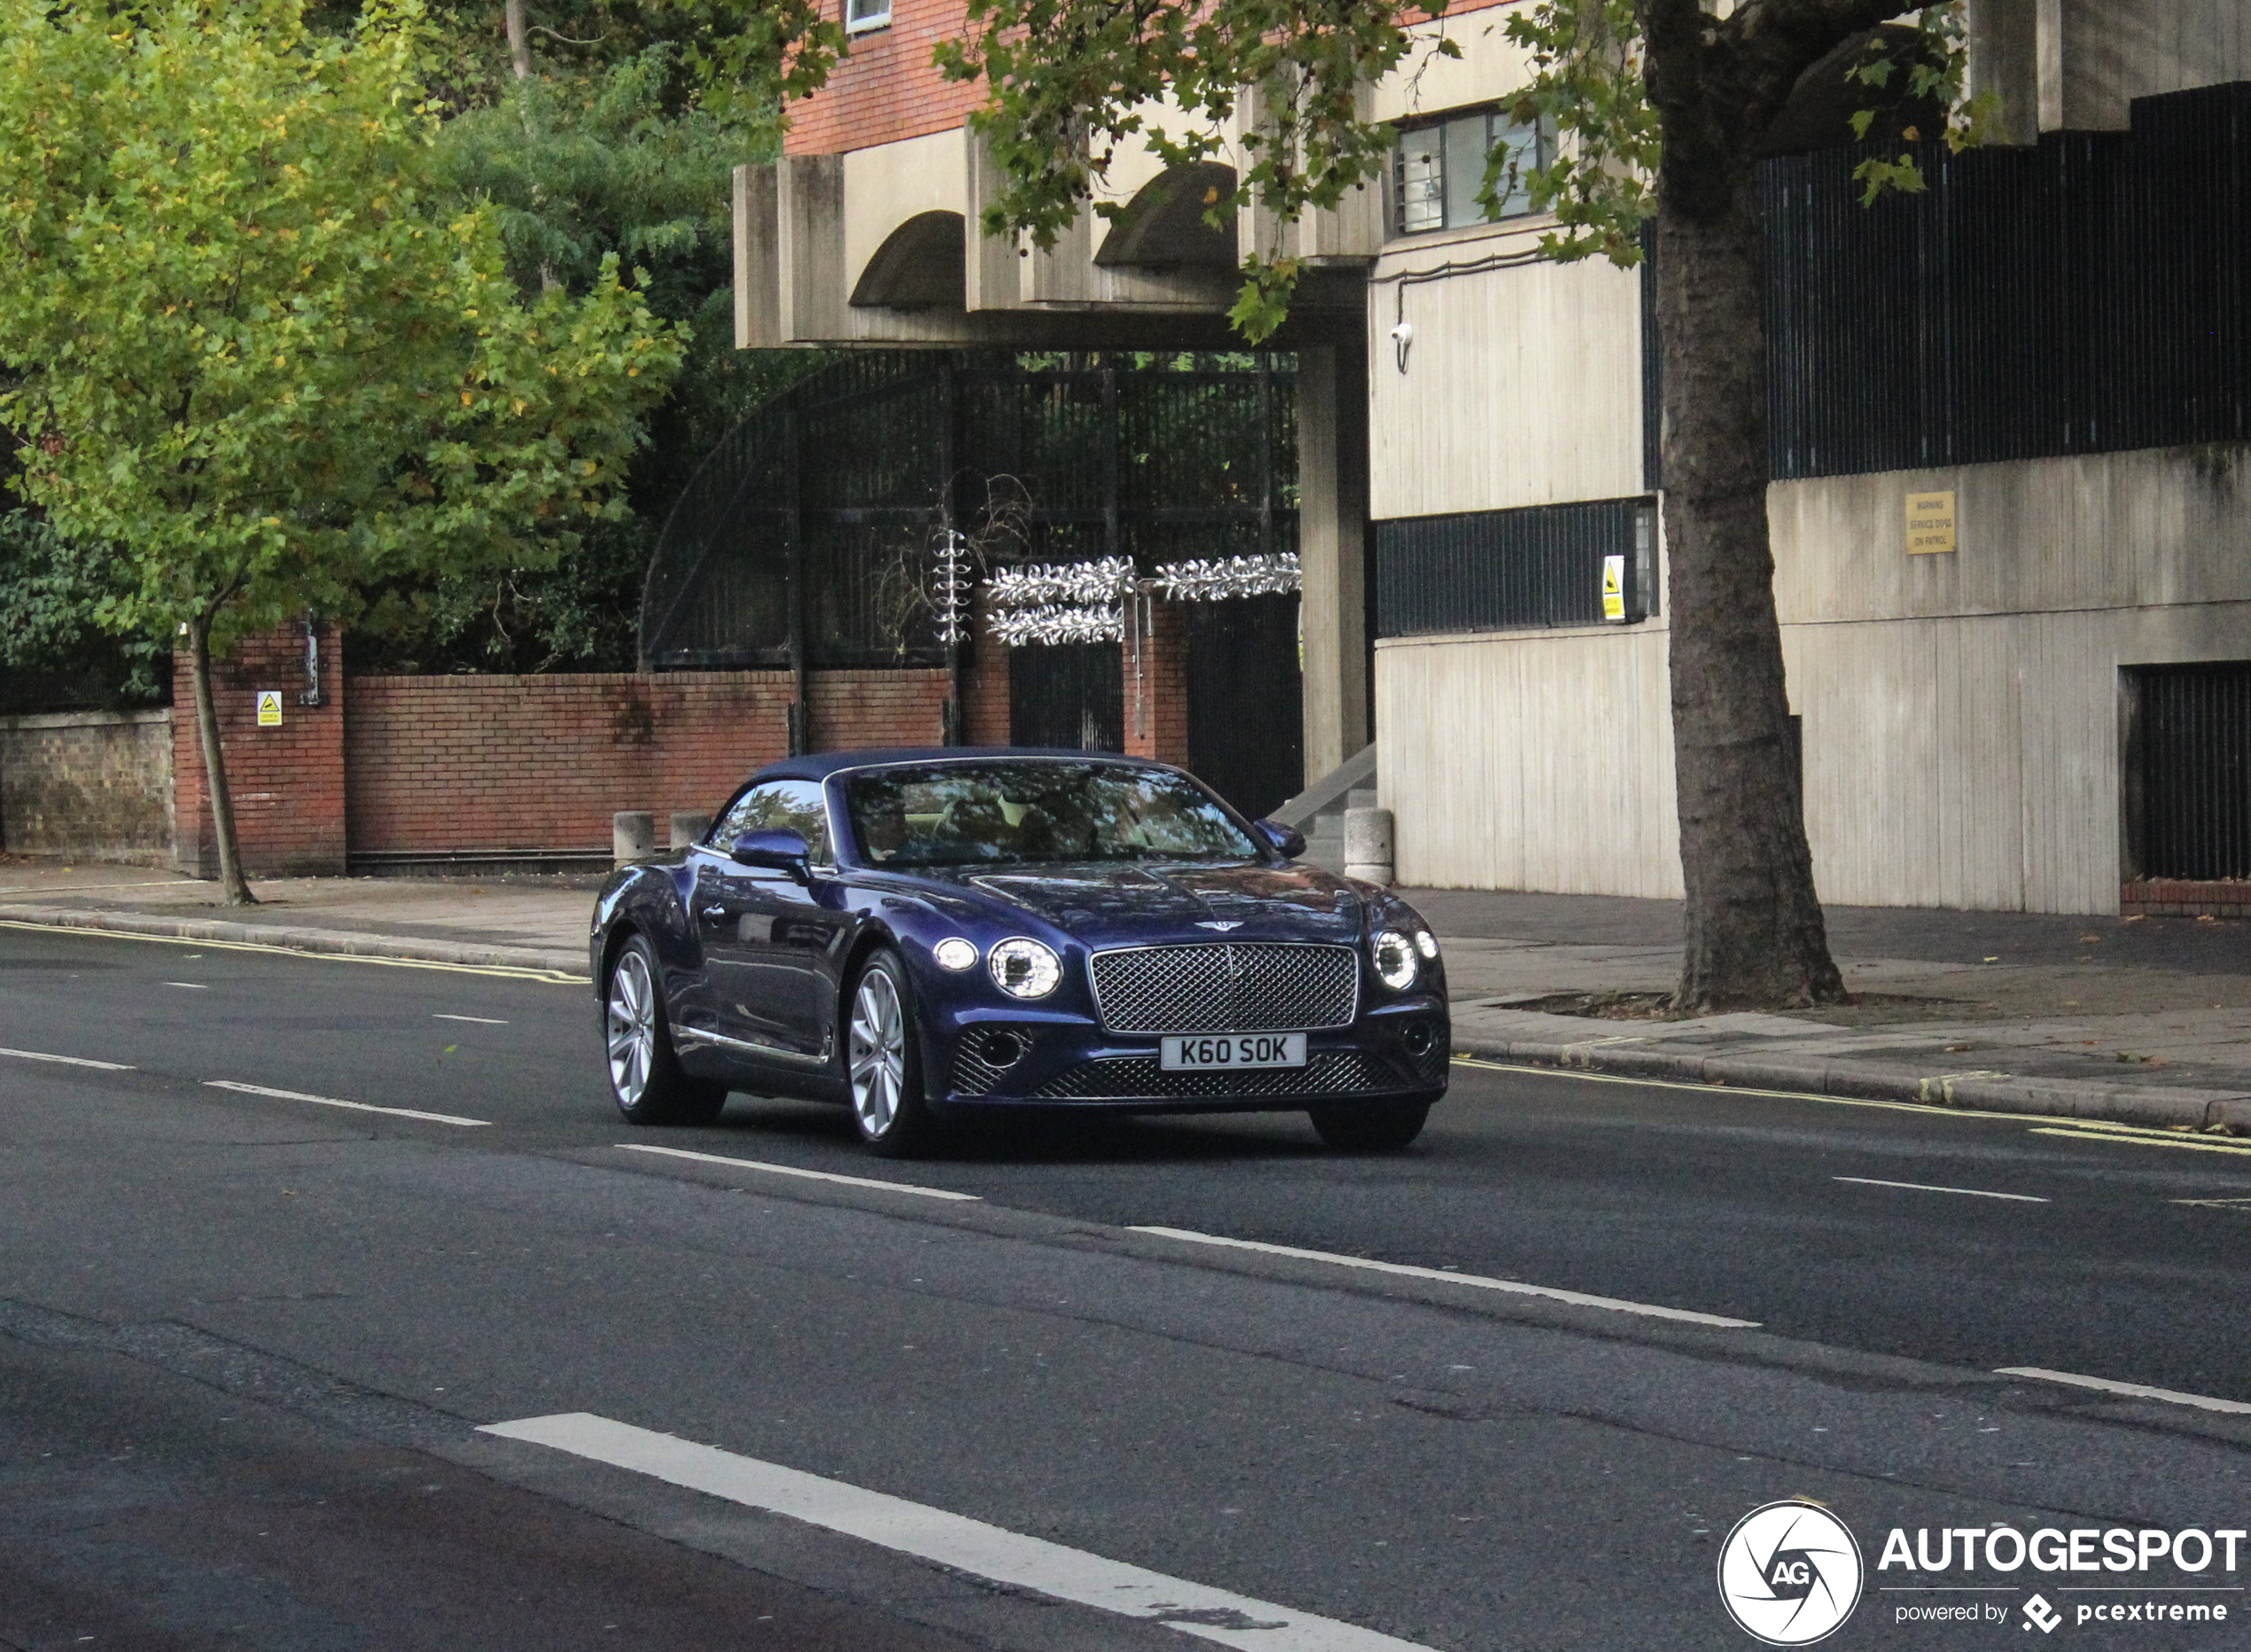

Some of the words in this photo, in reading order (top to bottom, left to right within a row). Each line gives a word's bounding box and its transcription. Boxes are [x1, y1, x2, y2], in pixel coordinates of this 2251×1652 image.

[1917, 500, 1943, 510] WARNING
[1910, 519, 1934, 529] SERVICE
[1936, 518, 1951, 528] DOGS
[1915, 537, 1924, 546] ON
[1925, 535, 1947, 545] PATROL
[1181, 1040, 1231, 1064] K60
[1240, 1037, 1287, 1062] SOK
